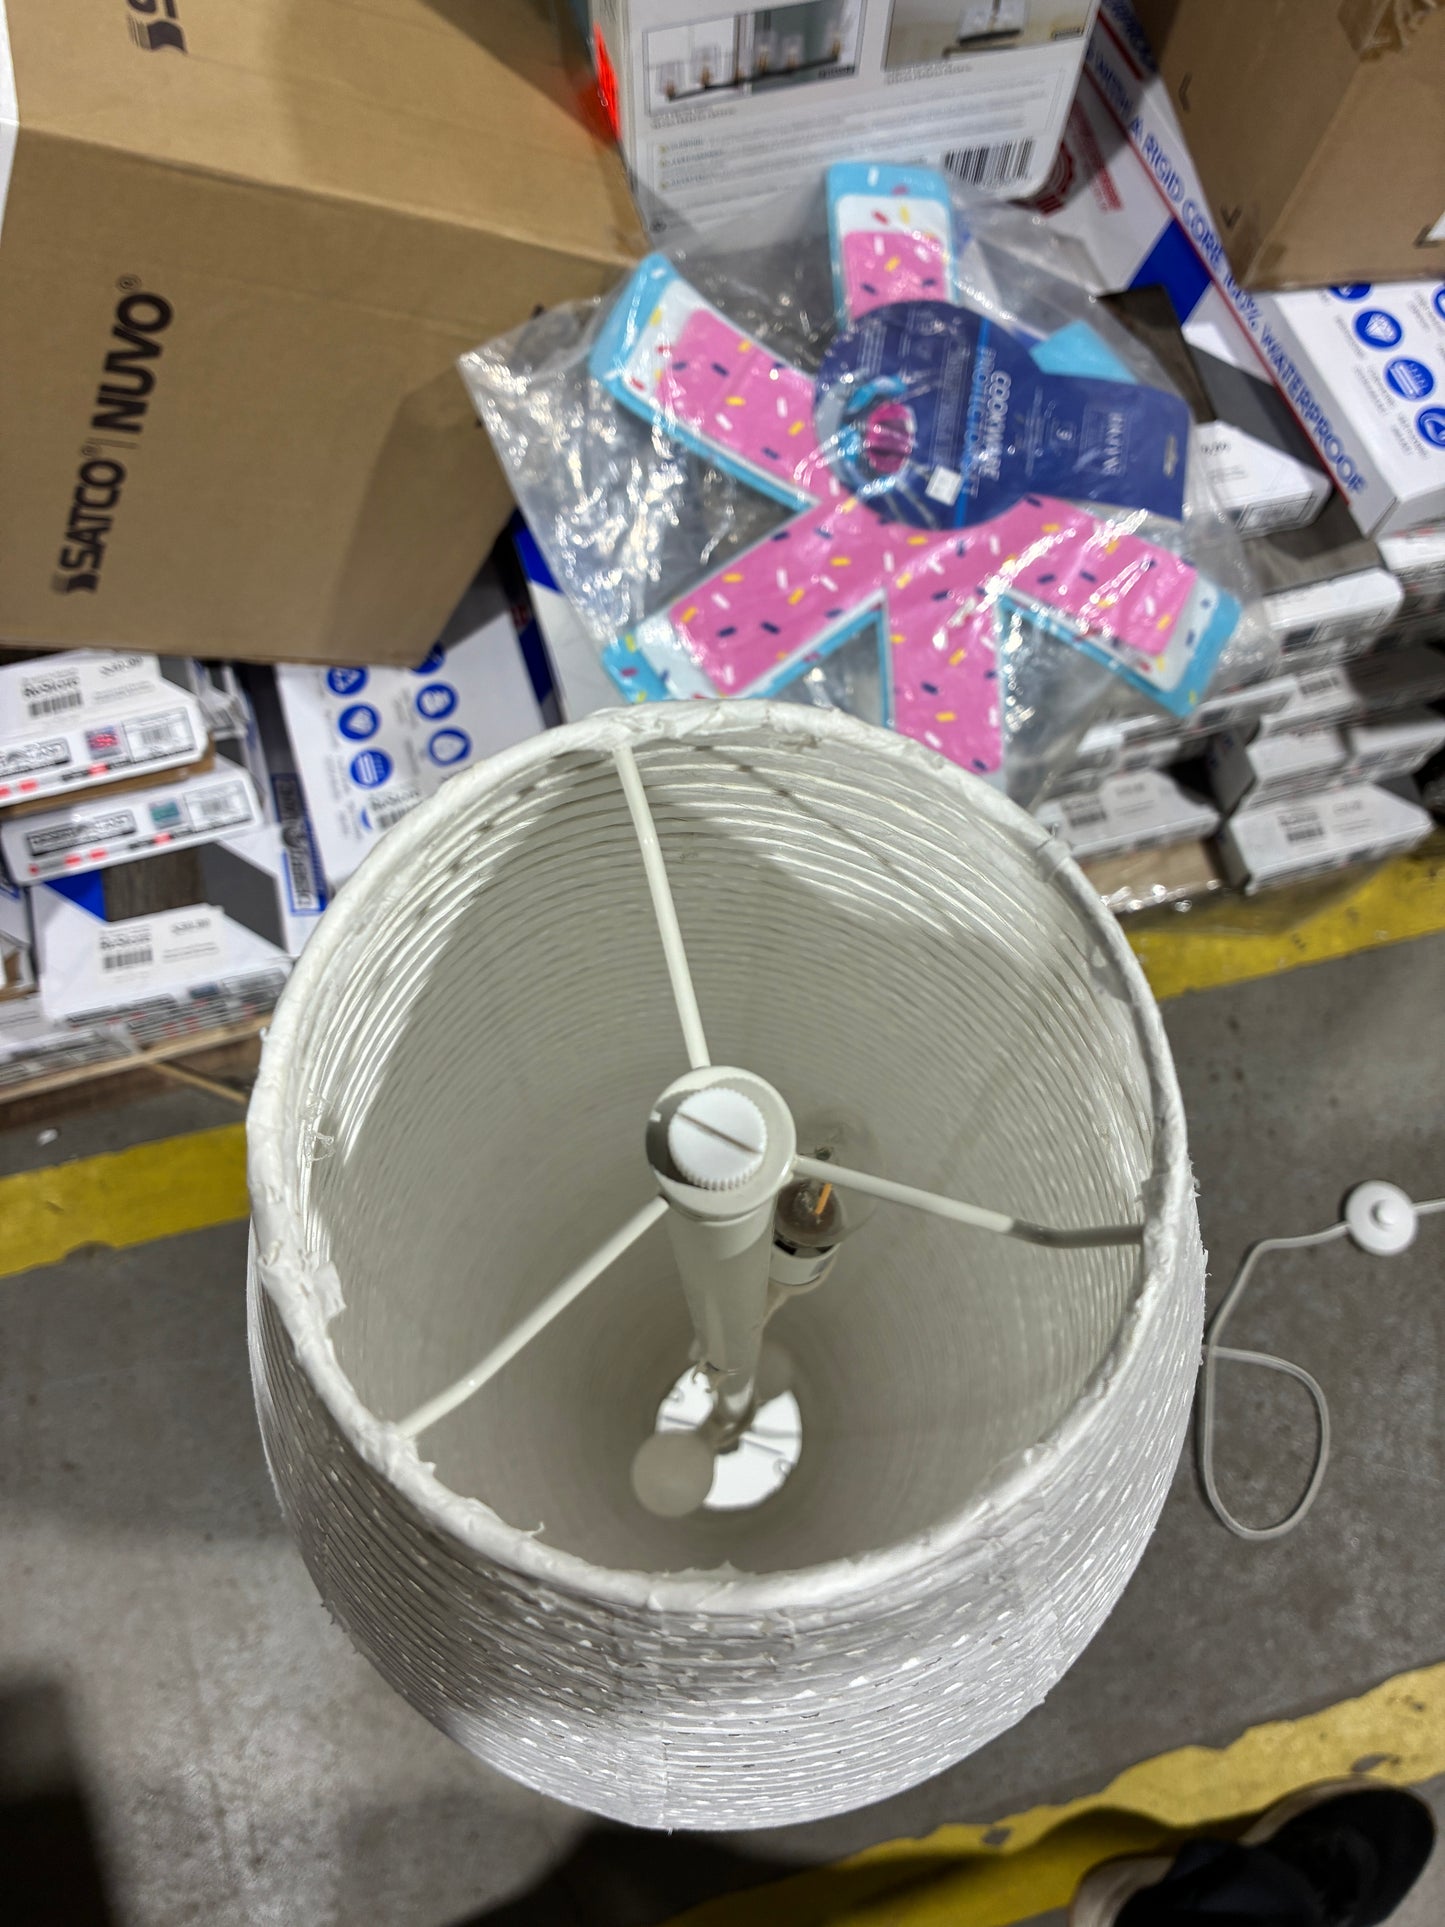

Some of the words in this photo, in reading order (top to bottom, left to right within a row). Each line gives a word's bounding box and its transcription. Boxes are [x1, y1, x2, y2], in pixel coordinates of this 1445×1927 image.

[1142, 133, 1186, 203] RIGID
[1182, 201, 1226, 274] CORE
[1223, 273, 1264, 333] 100%
[1260, 322, 1367, 485] WATERPROOF
